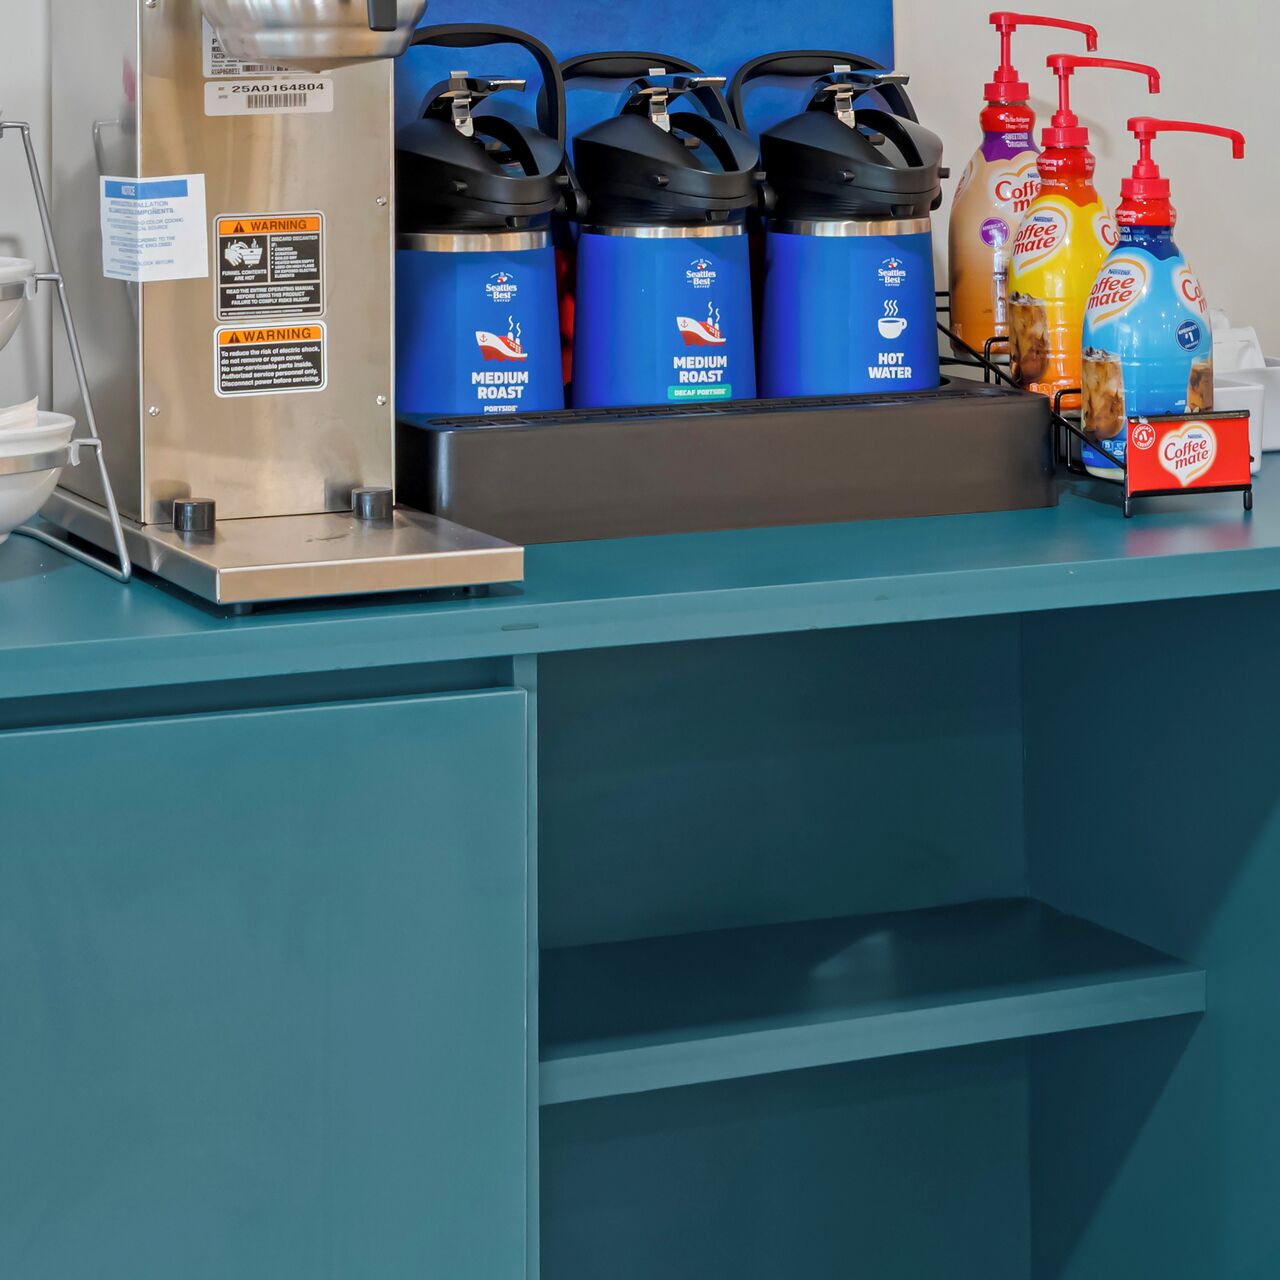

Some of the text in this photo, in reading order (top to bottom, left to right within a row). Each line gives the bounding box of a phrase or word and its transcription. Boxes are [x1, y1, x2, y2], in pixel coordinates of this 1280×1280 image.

[231, 82, 325, 93] 25A0164804
[995, 180, 1041, 202] Coffe
[251, 219, 307, 231] WARNING
[1016, 223, 1058, 242] offee
[1013, 236, 1056, 256] mate
[693, 278, 711, 286] Best
[884, 276, 901, 284] Best
[1090, 276, 1135, 296] offee
[493, 291, 511, 299] Best
[1087, 290, 1133, 310] mate
[243, 327, 312, 342] WARNING
[673, 355, 728, 369] MEDIUM
[878, 352, 904, 365] HOT
[222, 372, 253, 380] Authorized
[471, 371, 529, 385] MEDIUM
[680, 370, 723, 383] ROAST
[868, 366, 912, 379] WATER
[477, 386, 524, 399] ROAST
[1164, 439, 1207, 462] Coffee
[1175, 449, 1209, 470] mate
